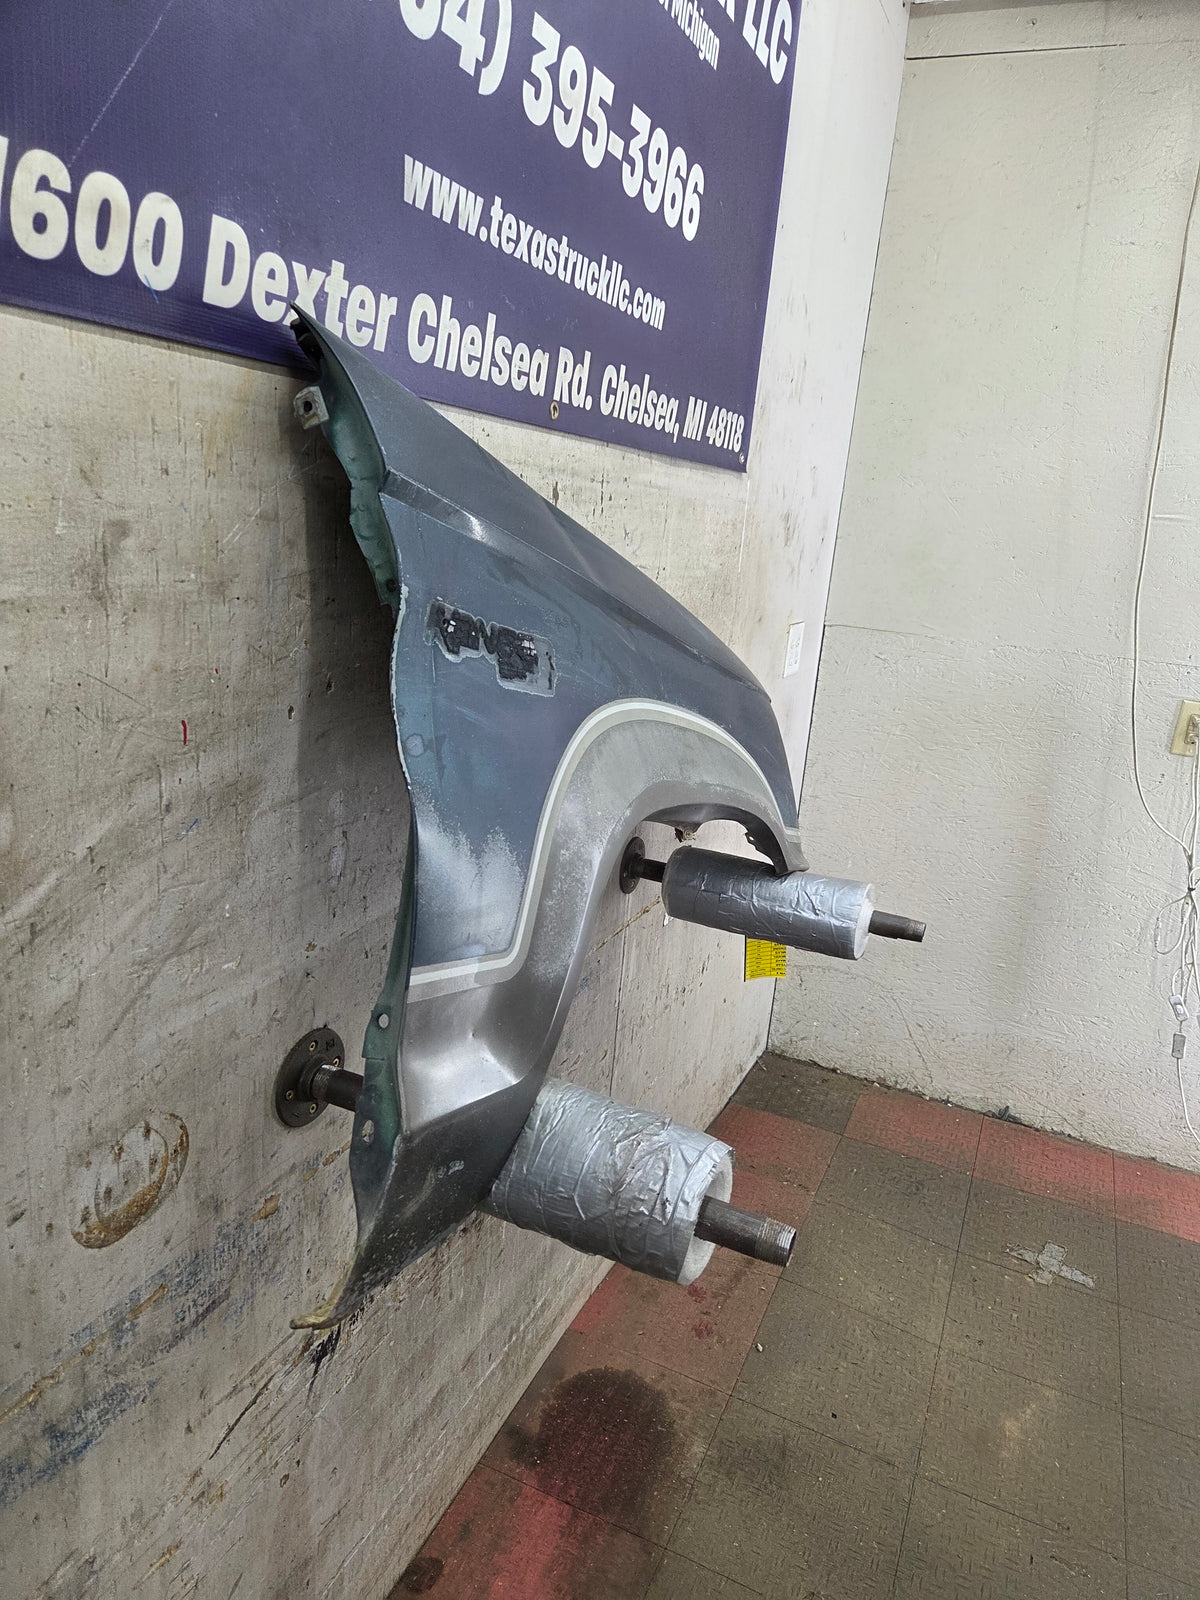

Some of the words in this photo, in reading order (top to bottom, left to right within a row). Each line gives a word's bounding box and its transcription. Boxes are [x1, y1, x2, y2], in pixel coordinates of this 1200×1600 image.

[522, 12, 704, 241] 395-3966
[0, 136, 184, 291] 600
[203, 214, 397, 352] Dexter
[408, 293, 549, 396] Chelsea
[553, 346, 593, 411] Rd.
[600, 364, 680, 443] Chelsea,
[682, 396, 707, 441] MI
[706, 406, 745, 452] 48118
[403, 154, 666, 330] www.texastruckllc.com
